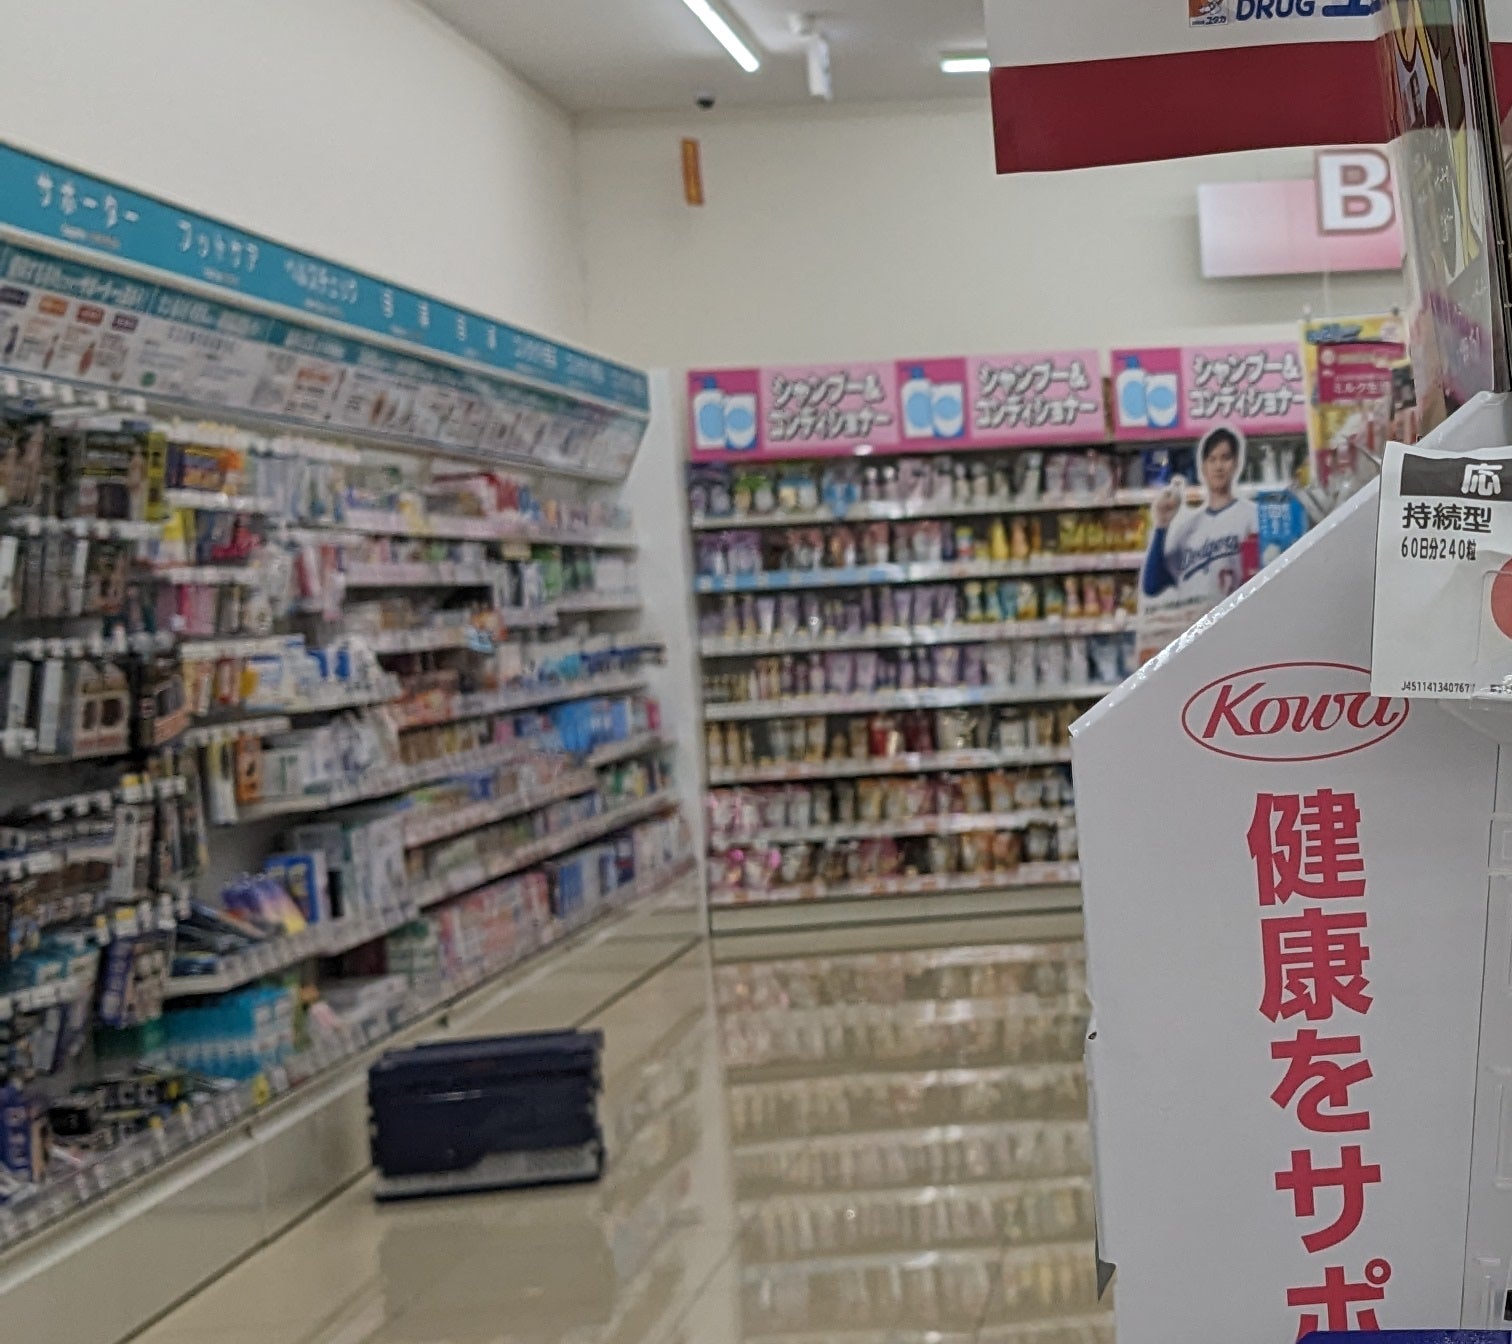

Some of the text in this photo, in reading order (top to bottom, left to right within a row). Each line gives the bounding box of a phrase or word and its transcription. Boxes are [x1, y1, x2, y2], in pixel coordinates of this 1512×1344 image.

[1402, 503, 1491, 532] 持続型
[1401, 537, 1476, 561] 60日分240粒
